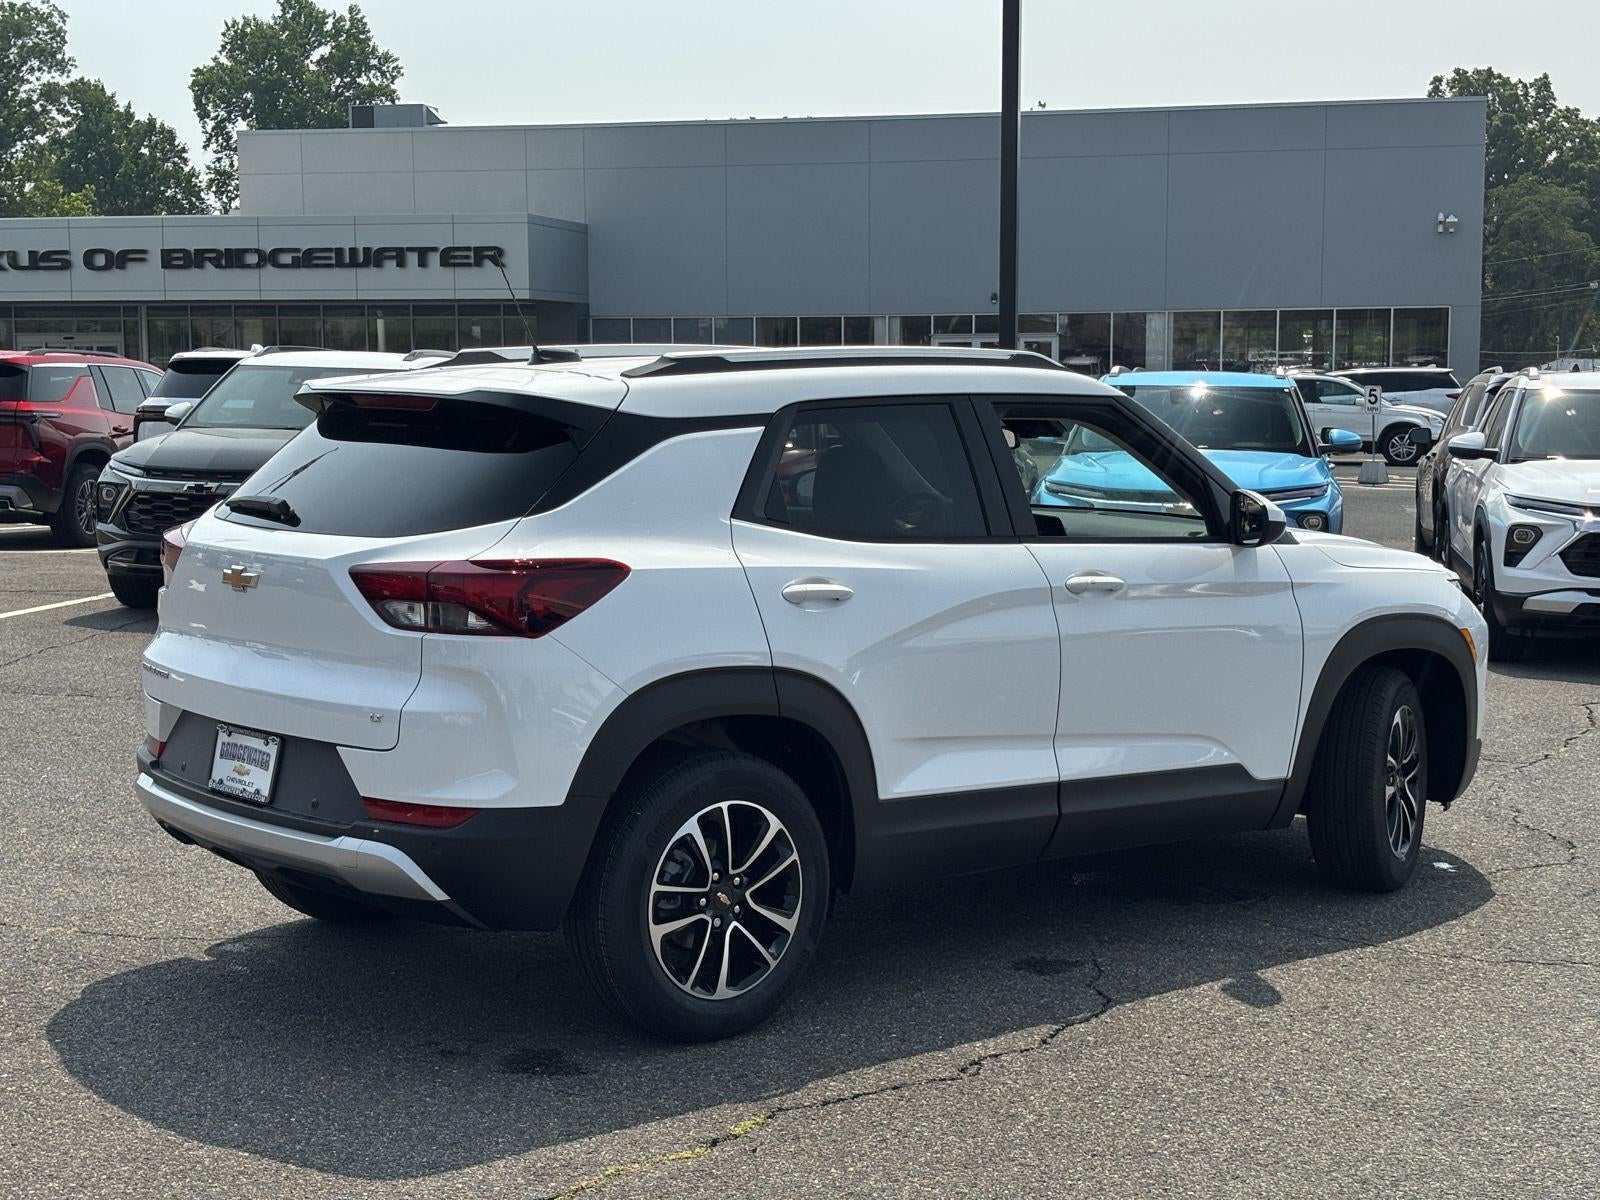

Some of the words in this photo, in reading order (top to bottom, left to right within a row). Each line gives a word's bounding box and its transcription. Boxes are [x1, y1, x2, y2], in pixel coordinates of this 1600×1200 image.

[0, 249, 72, 271] US
[82, 248, 149, 271] OF
[160, 245, 506, 270] BRIDGEWATER
[1368, 389, 1378, 405] 5
[219, 741, 271, 772] BRIDGEWATER
[226, 775, 254, 788] CHEVROLET
